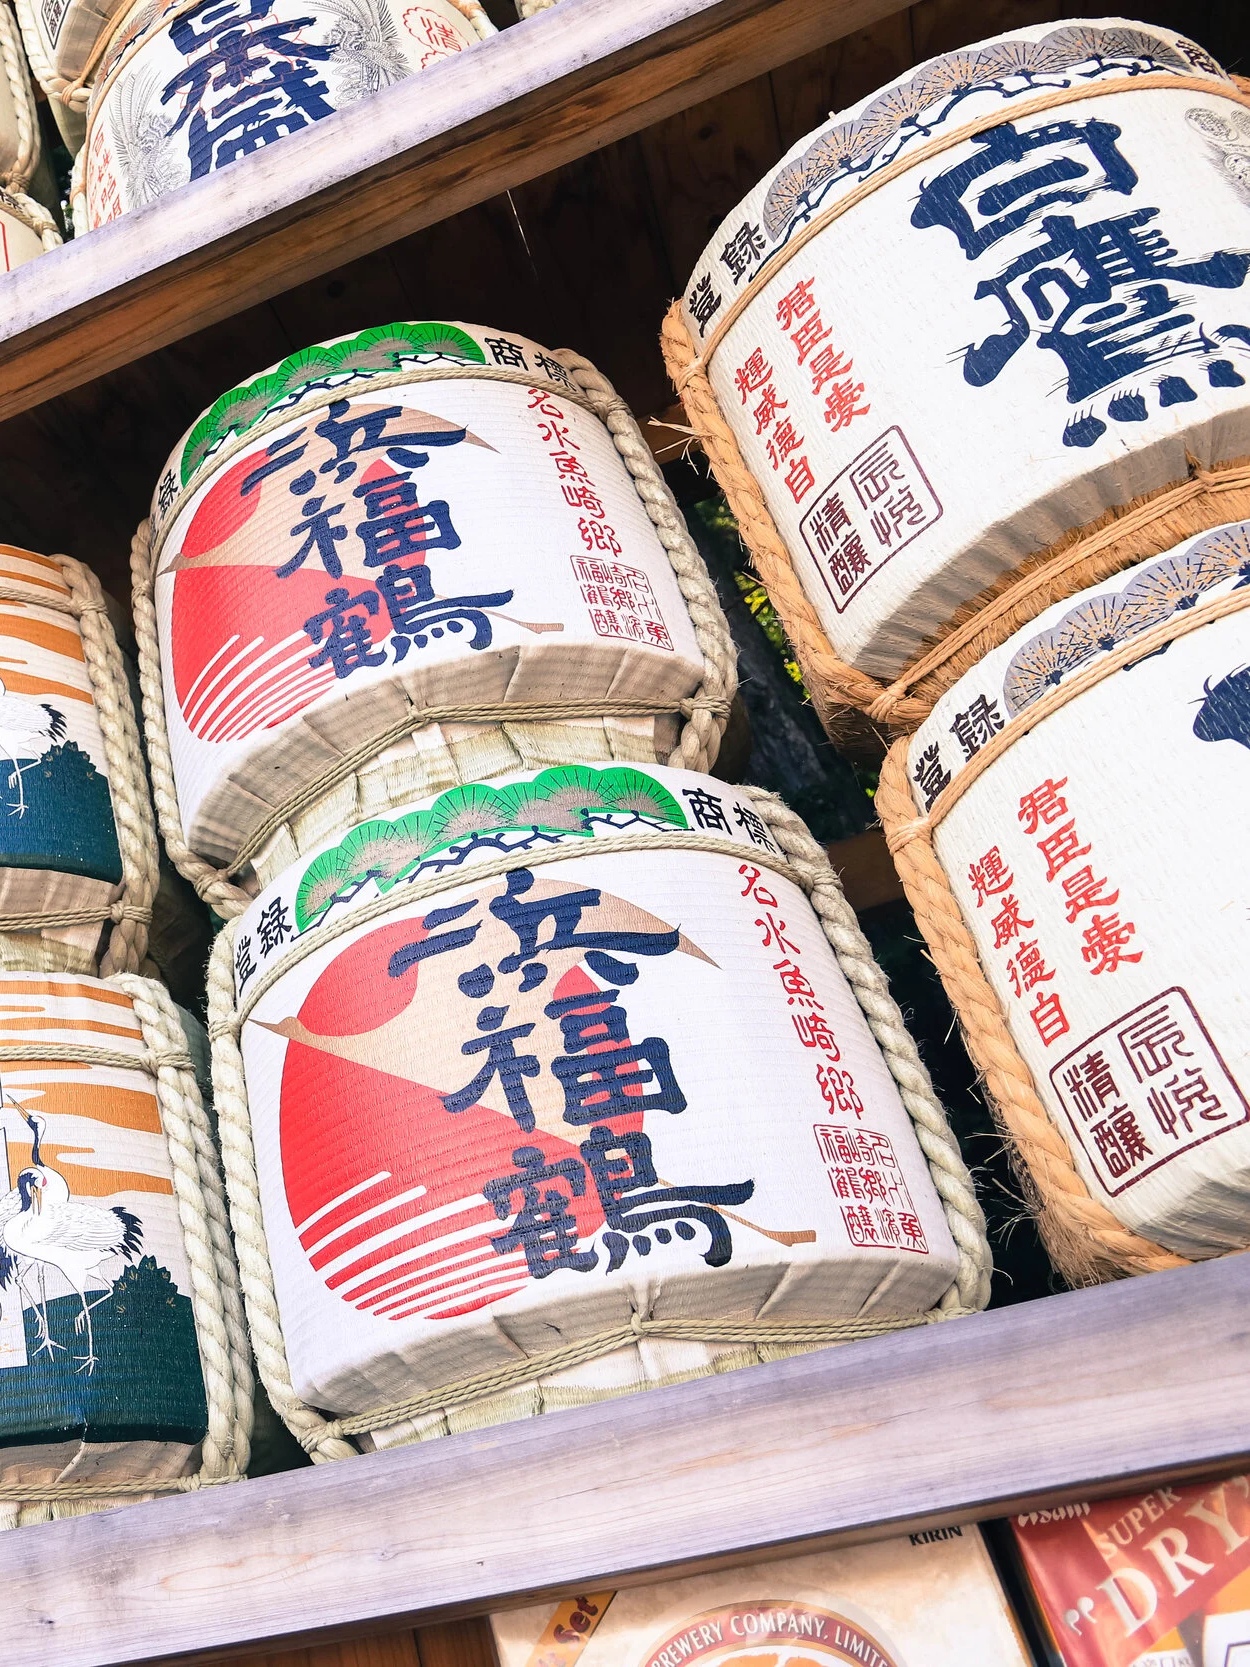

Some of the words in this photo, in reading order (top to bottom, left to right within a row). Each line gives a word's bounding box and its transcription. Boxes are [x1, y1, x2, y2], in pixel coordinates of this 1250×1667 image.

[484, 337, 578, 393] 商標
[240, 399, 514, 681] 浜福鶴
[682, 787, 777, 855] 商標
[235, 896, 293, 998] 登録
[388, 867, 755, 1279] 浜福鶴
[909, 1526, 963, 1546] KIRIN
[1095, 1486, 1183, 1560] SUPER
[553, 1595, 599, 1644] Set
[730, 1612, 829, 1640] COMPANY,
[834, 1625, 888, 1667] LIMIT
